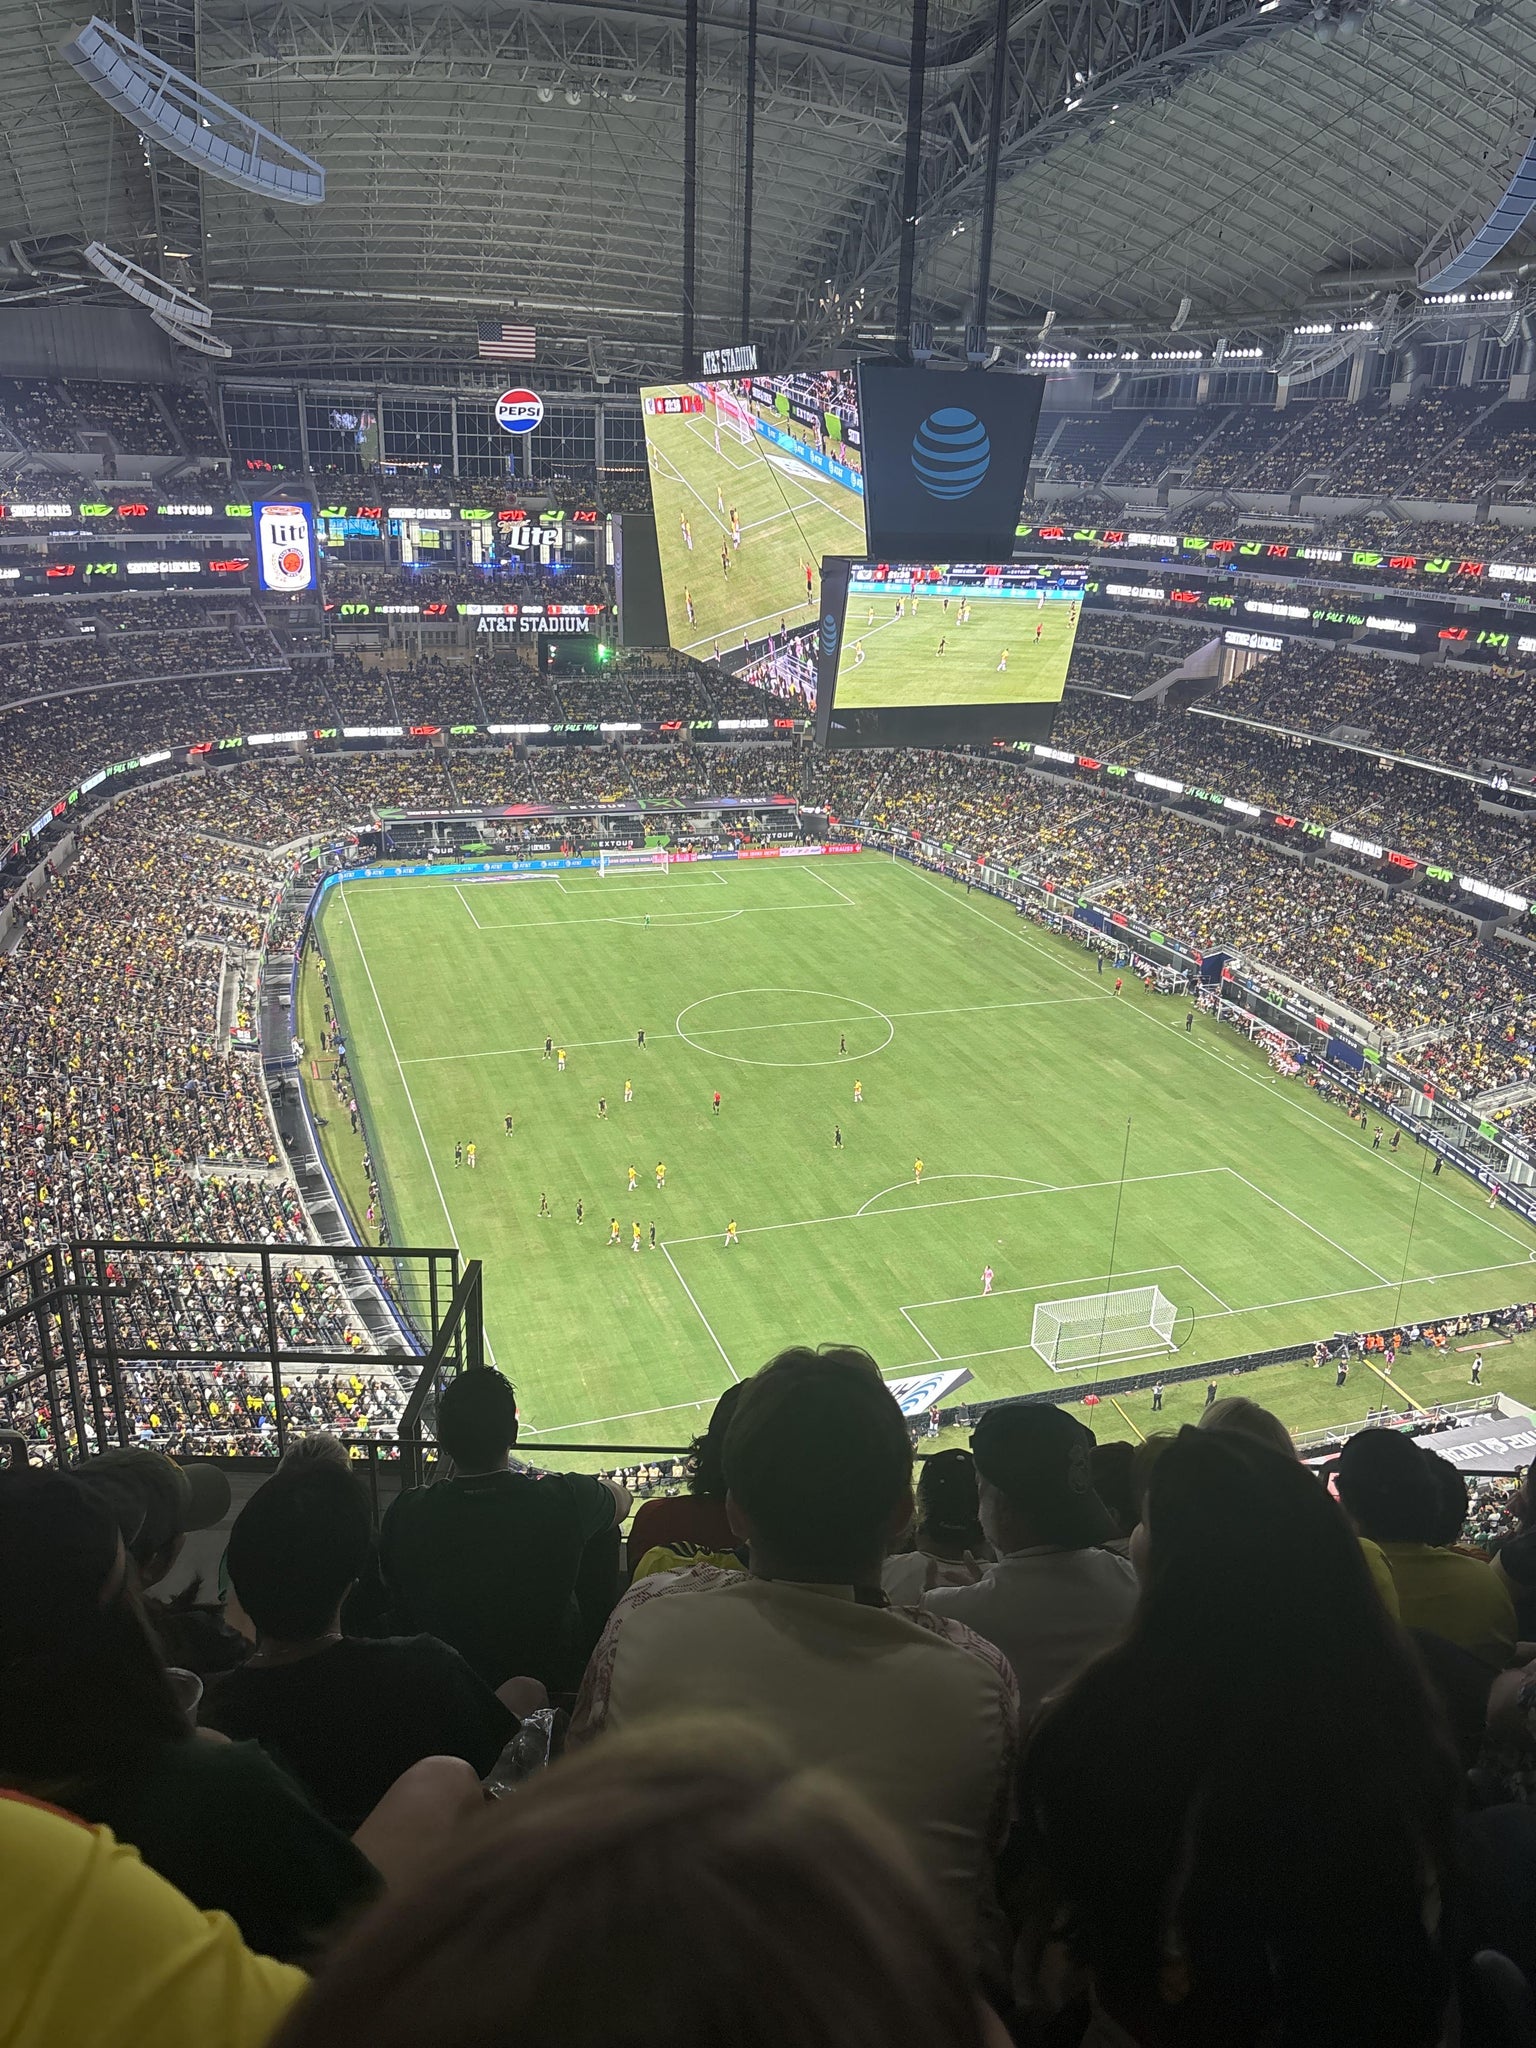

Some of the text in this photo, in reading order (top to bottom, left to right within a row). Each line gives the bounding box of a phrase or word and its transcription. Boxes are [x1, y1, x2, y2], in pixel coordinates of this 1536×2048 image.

[703, 344, 758, 375] AT&T STADIUM
[499, 406, 540, 417] PEPSI
[271, 524, 306, 547] Lite
[508, 526, 559, 550] Lite
[477, 617, 590, 632] AT&T STADIUM
[591, 840, 634, 848] MEXTOUR
